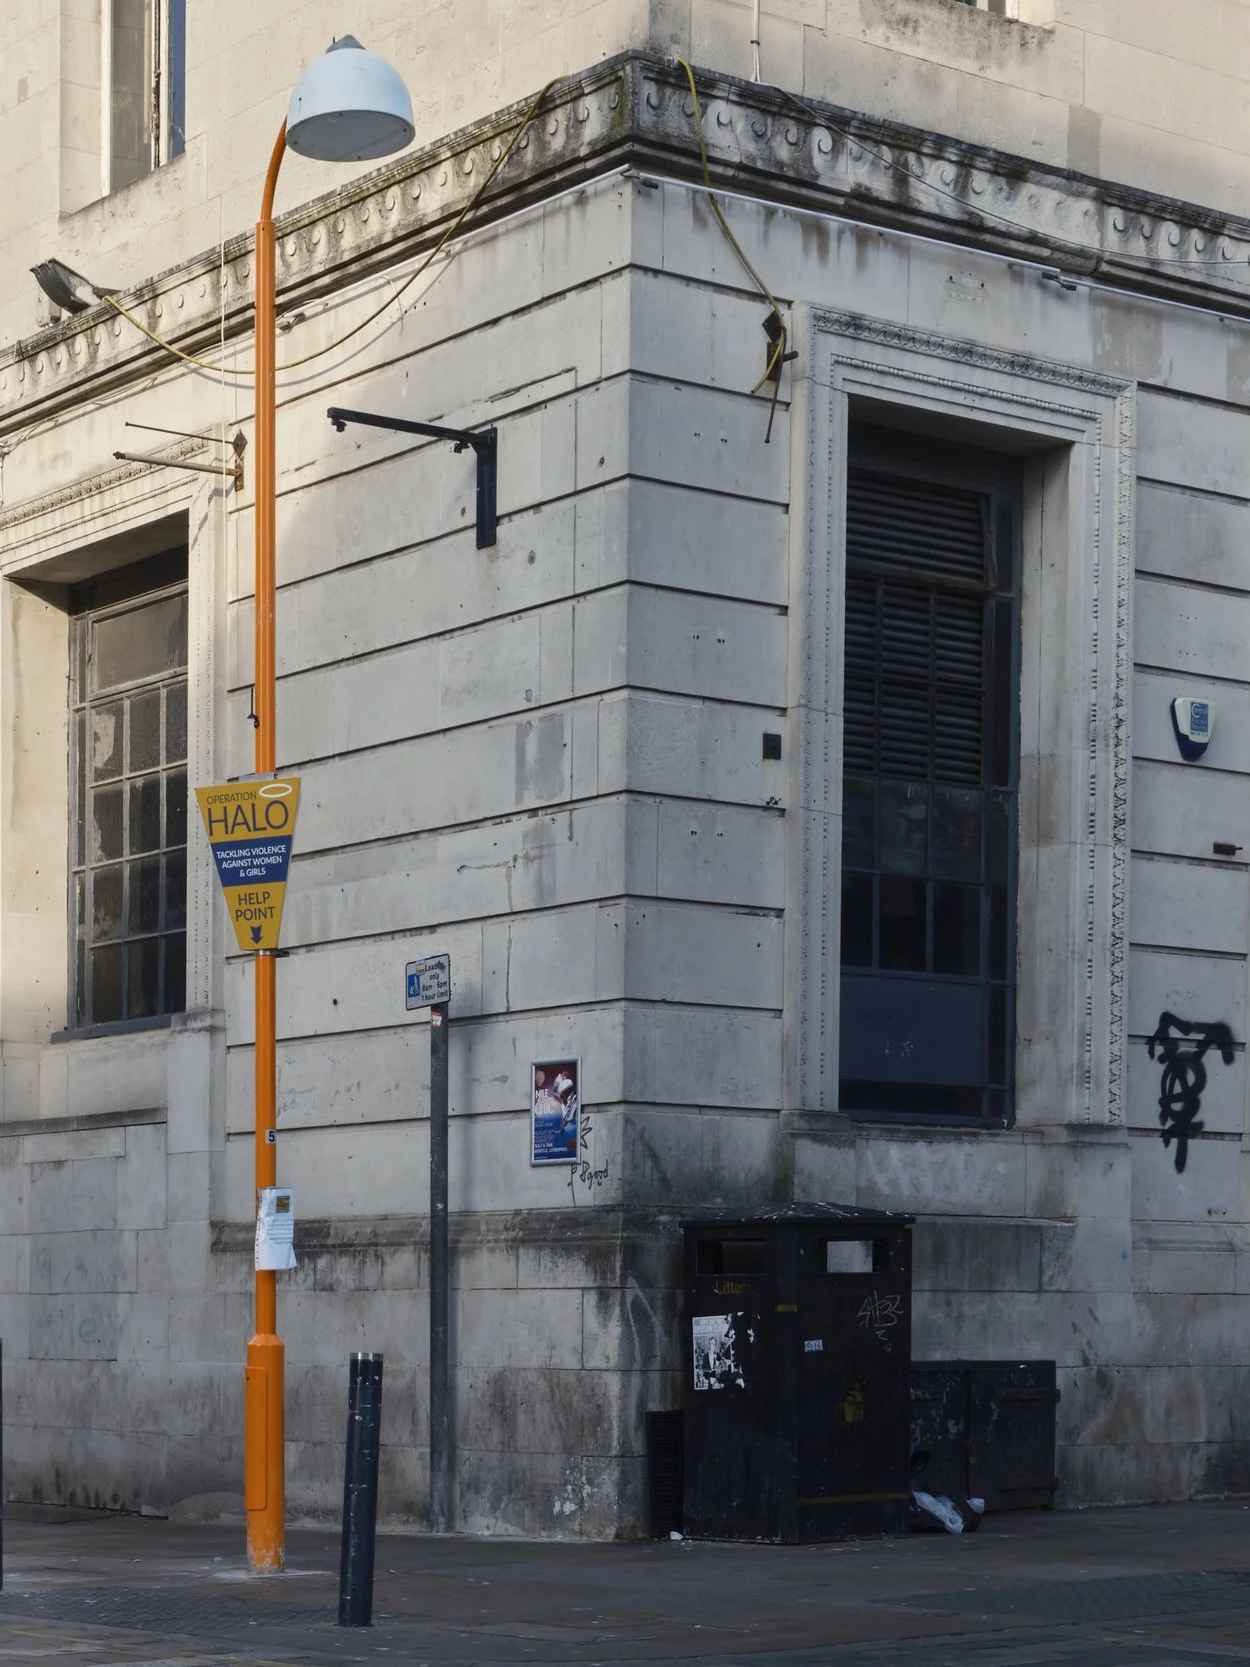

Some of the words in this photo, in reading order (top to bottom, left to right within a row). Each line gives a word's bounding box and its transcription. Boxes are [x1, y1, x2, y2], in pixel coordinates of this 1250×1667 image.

[206, 790, 257, 805] OPERATION
[207, 799, 289, 837] HALO
[216, 847, 251, 860] TACKLING
[250, 844, 286, 857] VIOLENCE
[221, 858, 251, 869] AGAINST
[252, 855, 282, 867] WOMEN
[239, 869, 246, 878] &
[246, 867, 266, 877] GIRLS
[237, 890, 271, 906] HELP
[235, 906, 276, 922] POINT
[268, 1131, 275, 1142] 5
